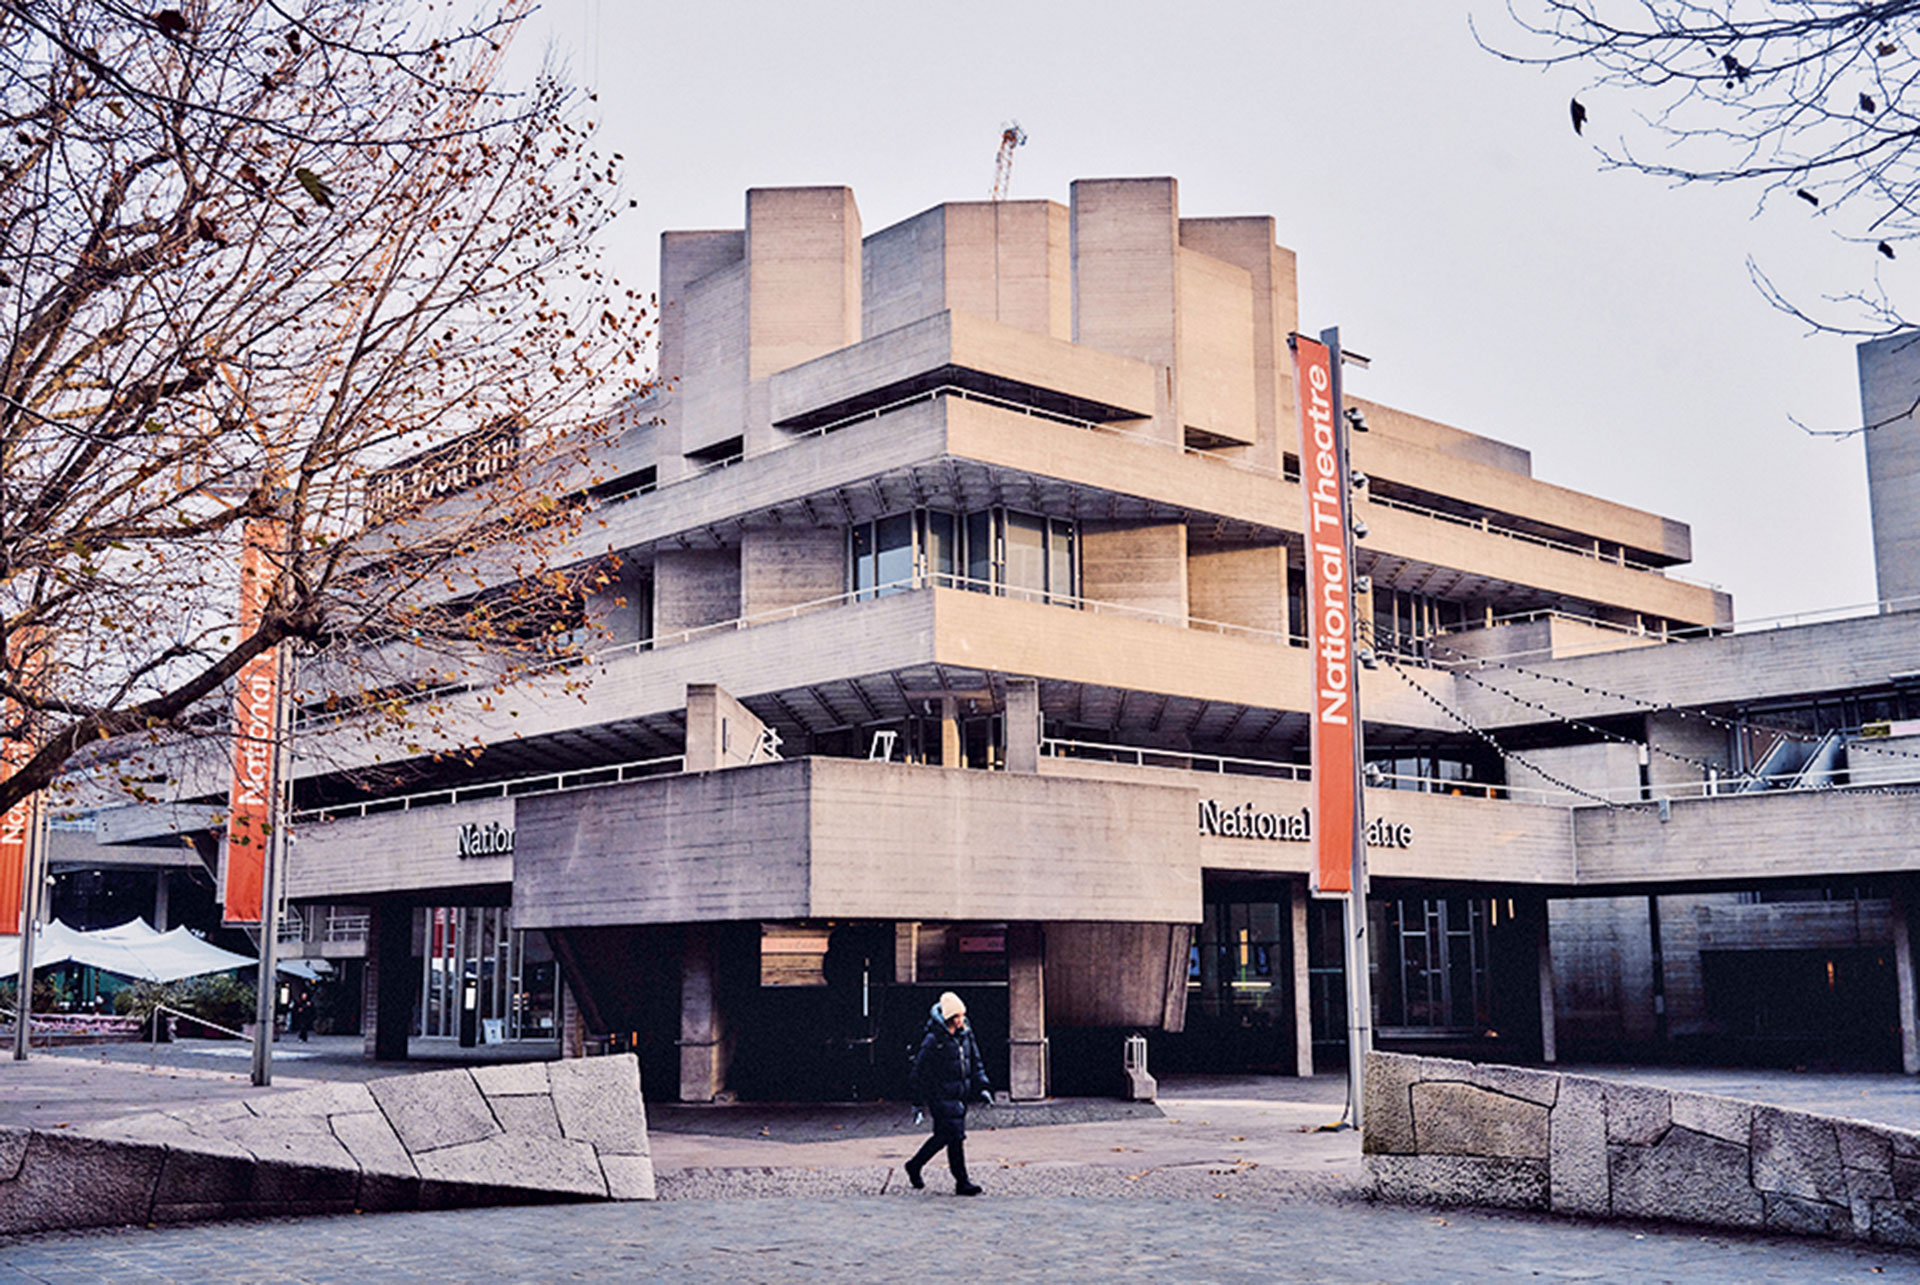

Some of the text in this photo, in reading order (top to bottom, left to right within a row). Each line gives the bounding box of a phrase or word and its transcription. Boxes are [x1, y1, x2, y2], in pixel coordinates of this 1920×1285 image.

[1308, 364, 1348, 725] National Theatre
[1198, 800, 1413, 849] National atre
